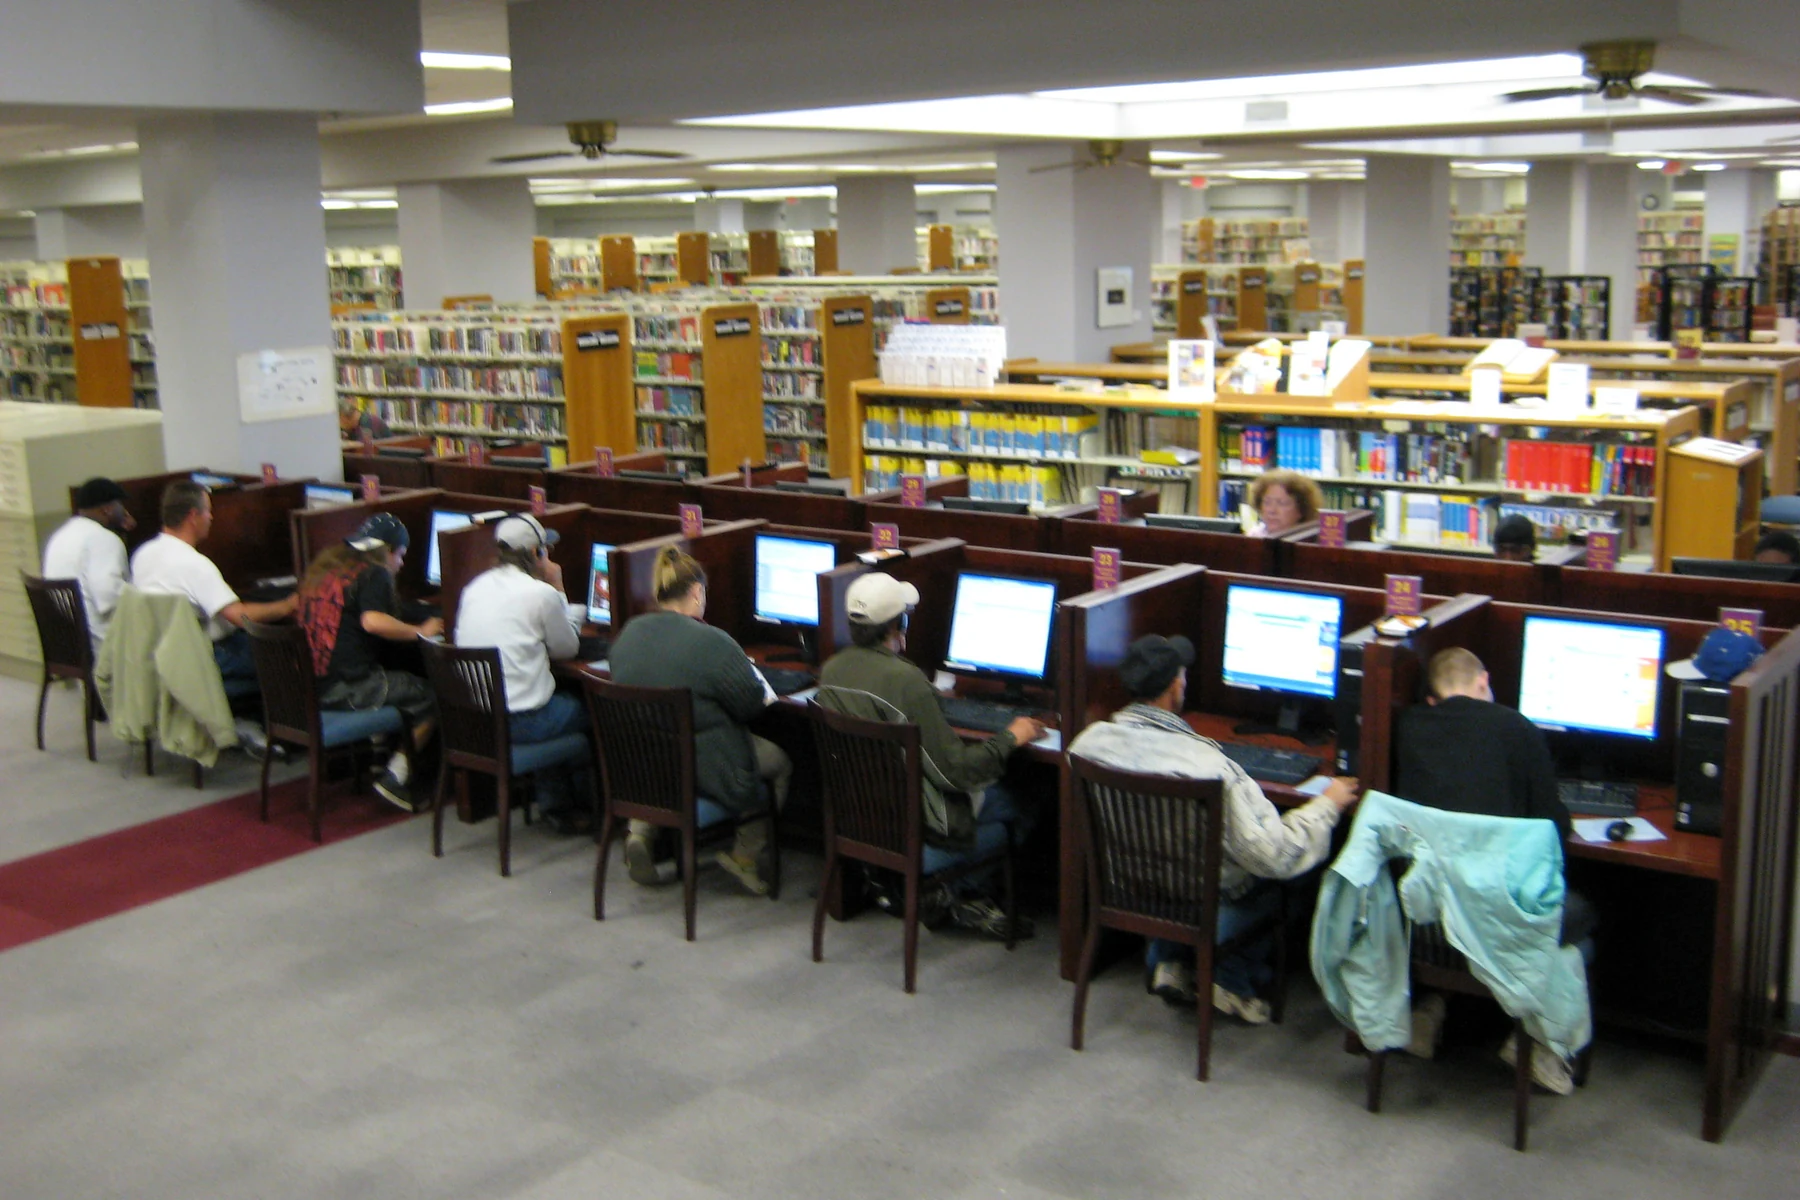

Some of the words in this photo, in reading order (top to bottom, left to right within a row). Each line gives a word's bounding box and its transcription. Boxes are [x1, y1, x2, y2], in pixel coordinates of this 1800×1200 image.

[685, 510, 696, 520] 21
[879, 529, 892, 542] 22
[1099, 553, 1112, 566] 23
[1393, 581, 1410, 593] 24
[1724, 618, 1753, 634] 25
